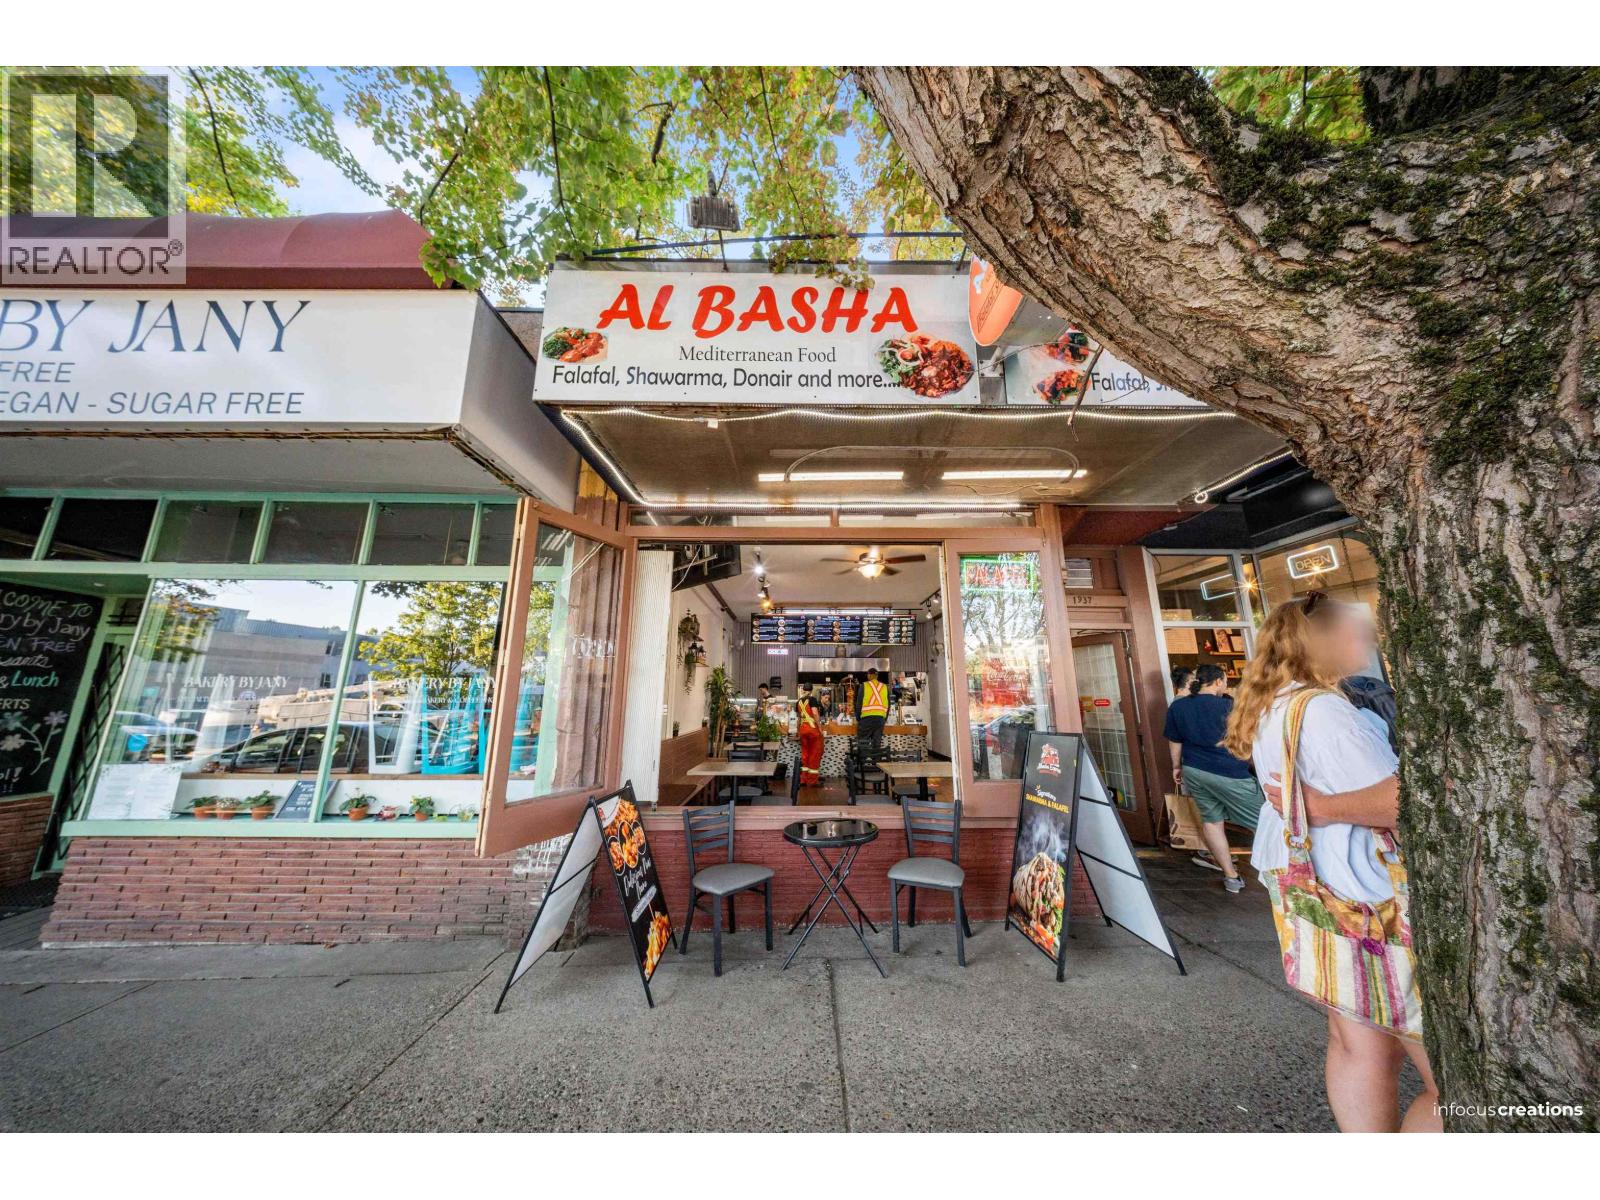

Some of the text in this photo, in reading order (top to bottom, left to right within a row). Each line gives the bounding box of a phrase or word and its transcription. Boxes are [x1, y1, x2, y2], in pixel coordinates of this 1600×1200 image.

[596, 283, 675, 331] AL
[692, 285, 919, 339] BASHA
[0, 299, 311, 353] BY JANY
[679, 346, 837, 363] Mediterranean Food
[552, 365, 620, 387] Falafal,
[626, 366, 728, 389] Shawarma,
[733, 368, 793, 388] Donair
[797, 369, 832, 388] and
[1090, 370, 1150, 393] Falafal,
[106, 391, 217, 414] SUGAR
[225, 392, 305, 414] FREE
[48, 617, 91, 642] Jany
[11, 670, 59, 688] Lunch
